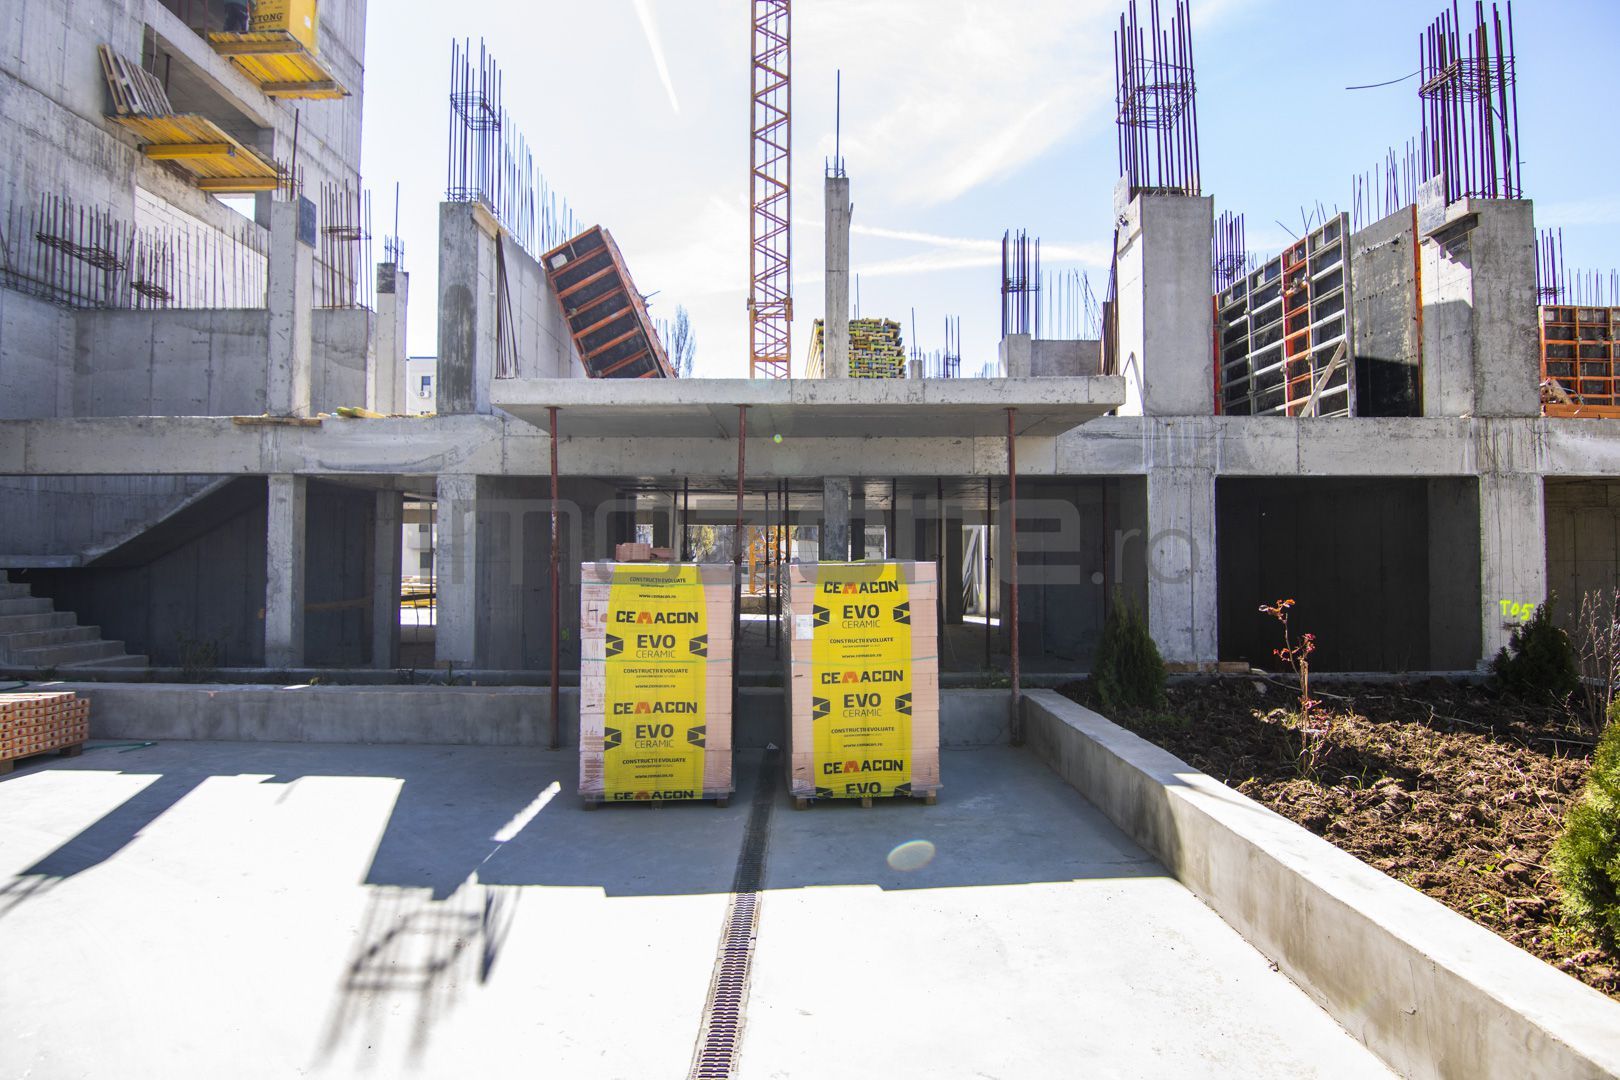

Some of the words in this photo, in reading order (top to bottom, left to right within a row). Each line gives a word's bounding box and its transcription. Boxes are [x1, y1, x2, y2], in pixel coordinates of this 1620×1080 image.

[823, 580, 899, 595] CEMACON
[616, 610, 699, 625] CEMACON
[843, 604, 880, 619] EVO
[841, 619, 881, 629] CERAMIC
[637, 634, 676, 649] EVO
[635, 650, 676, 659] CERAMIC
[821, 670, 904, 685] CEMACON
[613, 701, 698, 715] CEMACON
[843, 693, 882, 709] EVO
[842, 708, 882, 718] CERAMIC
[635, 723, 675, 739] EVO
[634, 739, 675, 749] CERAMIC
[823, 760, 904, 775] CEMACON
[614, 789, 695, 800] CEMACON
[845, 782, 882, 794] EVO
